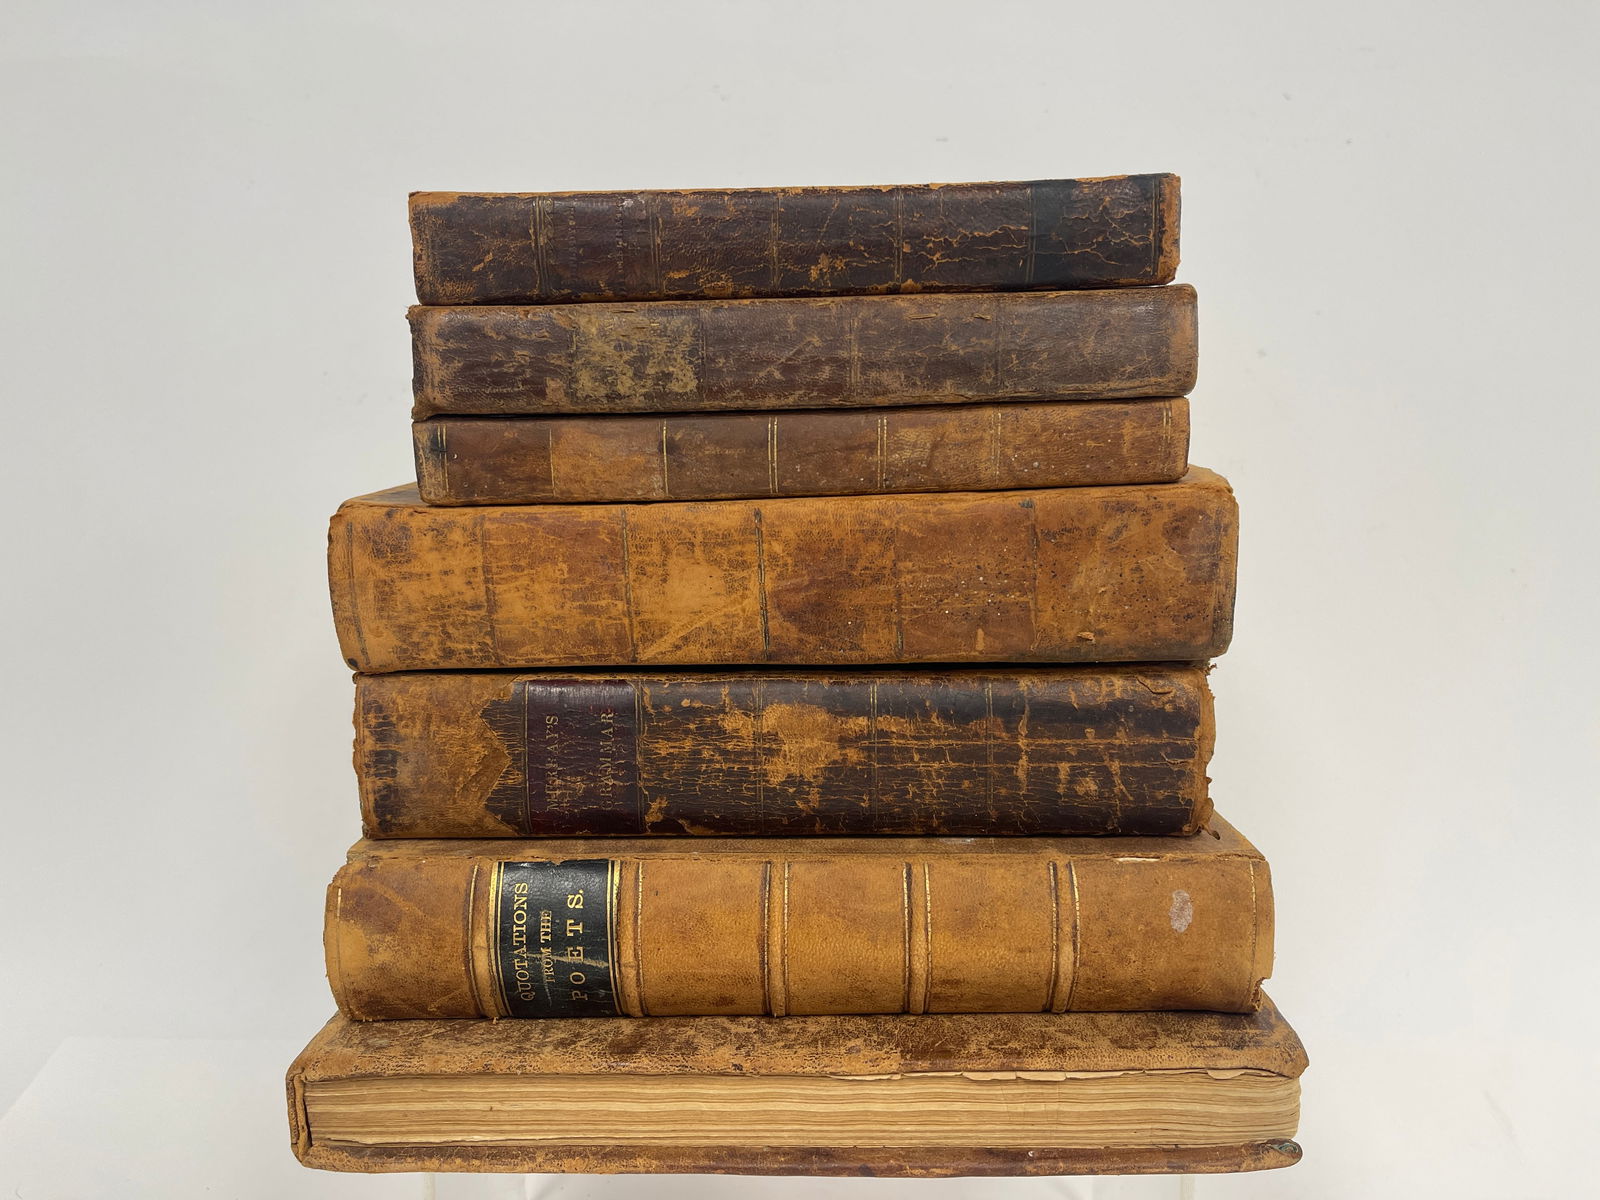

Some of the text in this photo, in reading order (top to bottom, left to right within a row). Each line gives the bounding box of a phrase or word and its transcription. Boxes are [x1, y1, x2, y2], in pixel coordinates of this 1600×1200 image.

[599, 711, 614, 811] GRAMMAR
[513, 882, 536, 1001] QUOTATIONS
[539, 910, 556, 983] FROM THE
